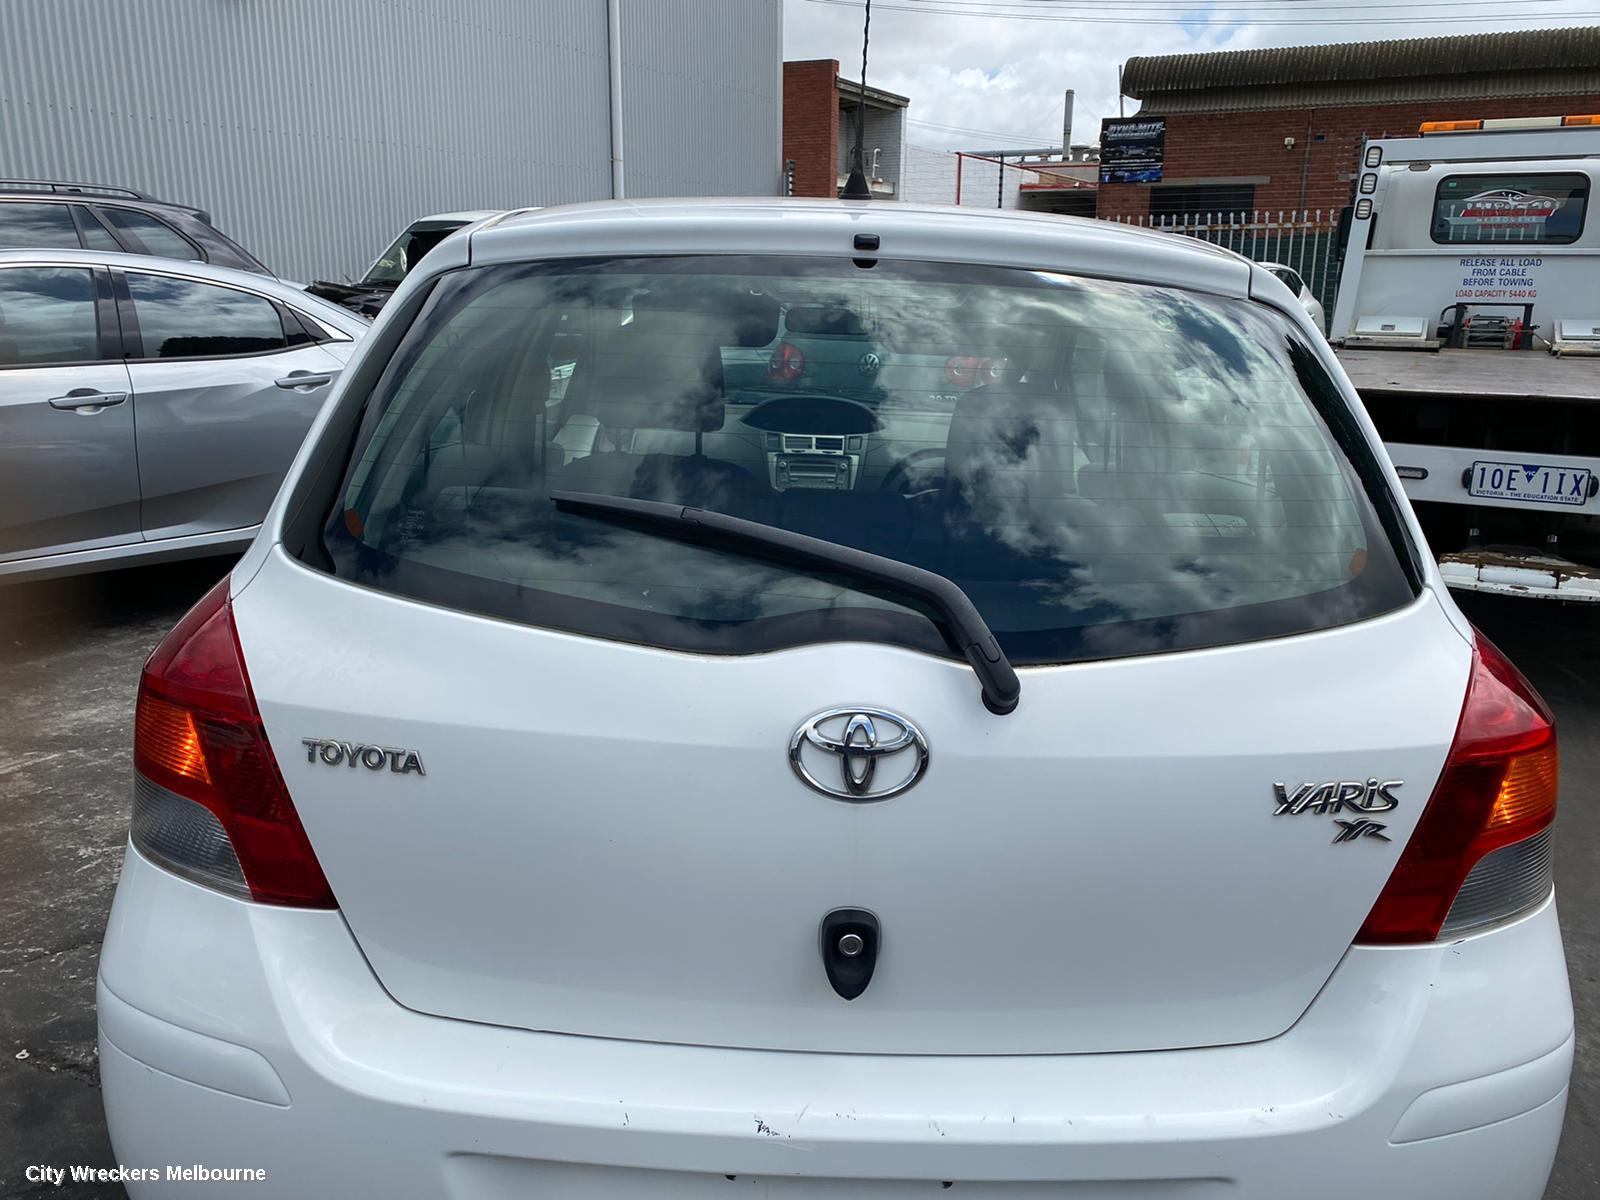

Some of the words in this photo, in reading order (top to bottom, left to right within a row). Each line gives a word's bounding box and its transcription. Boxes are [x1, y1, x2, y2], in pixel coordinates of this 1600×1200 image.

[1460, 259, 1496, 267] RELEASE
[1500, 259, 1515, 267] ALL
[1519, 259, 1542, 267] LOAD
[1463, 278, 1494, 286] BEFORE
[1499, 278, 1533, 287] TOWING
[302, 737, 426, 776] TOYOTA
